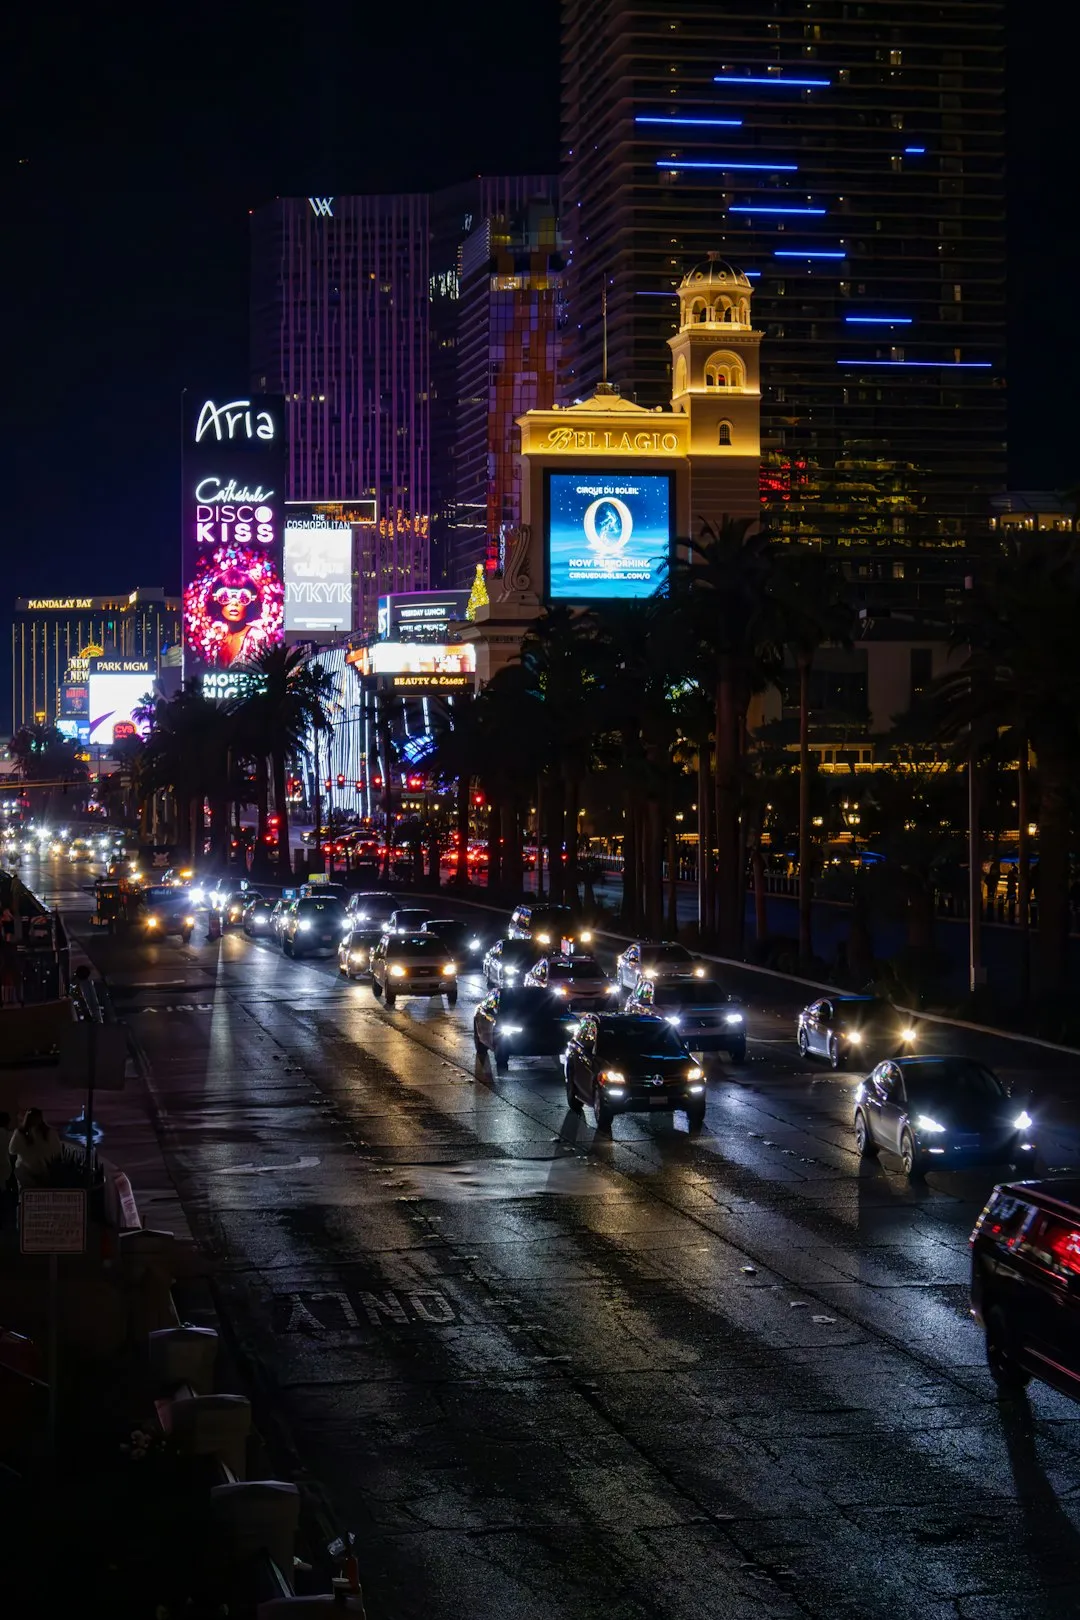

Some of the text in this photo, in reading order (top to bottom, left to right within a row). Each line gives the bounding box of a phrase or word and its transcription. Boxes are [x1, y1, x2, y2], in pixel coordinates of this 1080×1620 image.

[540, 427, 679, 452] BELLAGIO
[576, 486, 603, 496] CIRQUE
[604, 486, 614, 494] DU
[196, 505, 273, 522] DISCO
[312, 513, 326, 521] THE
[286, 520, 351, 530] COSMOPOLITAN
[196, 523, 275, 543] KISS
[569, 559, 591, 568] NOW
[28, 599, 93, 609] MANDALAY BAY
[70, 658, 89, 669] NEW
[97, 662, 149, 671] PARK MGM
[70, 670, 89, 681] NEW
[394, 677, 430, 686] BEAUTY
[431, 677, 438, 685] &
[115, 725, 134, 734] CVS
